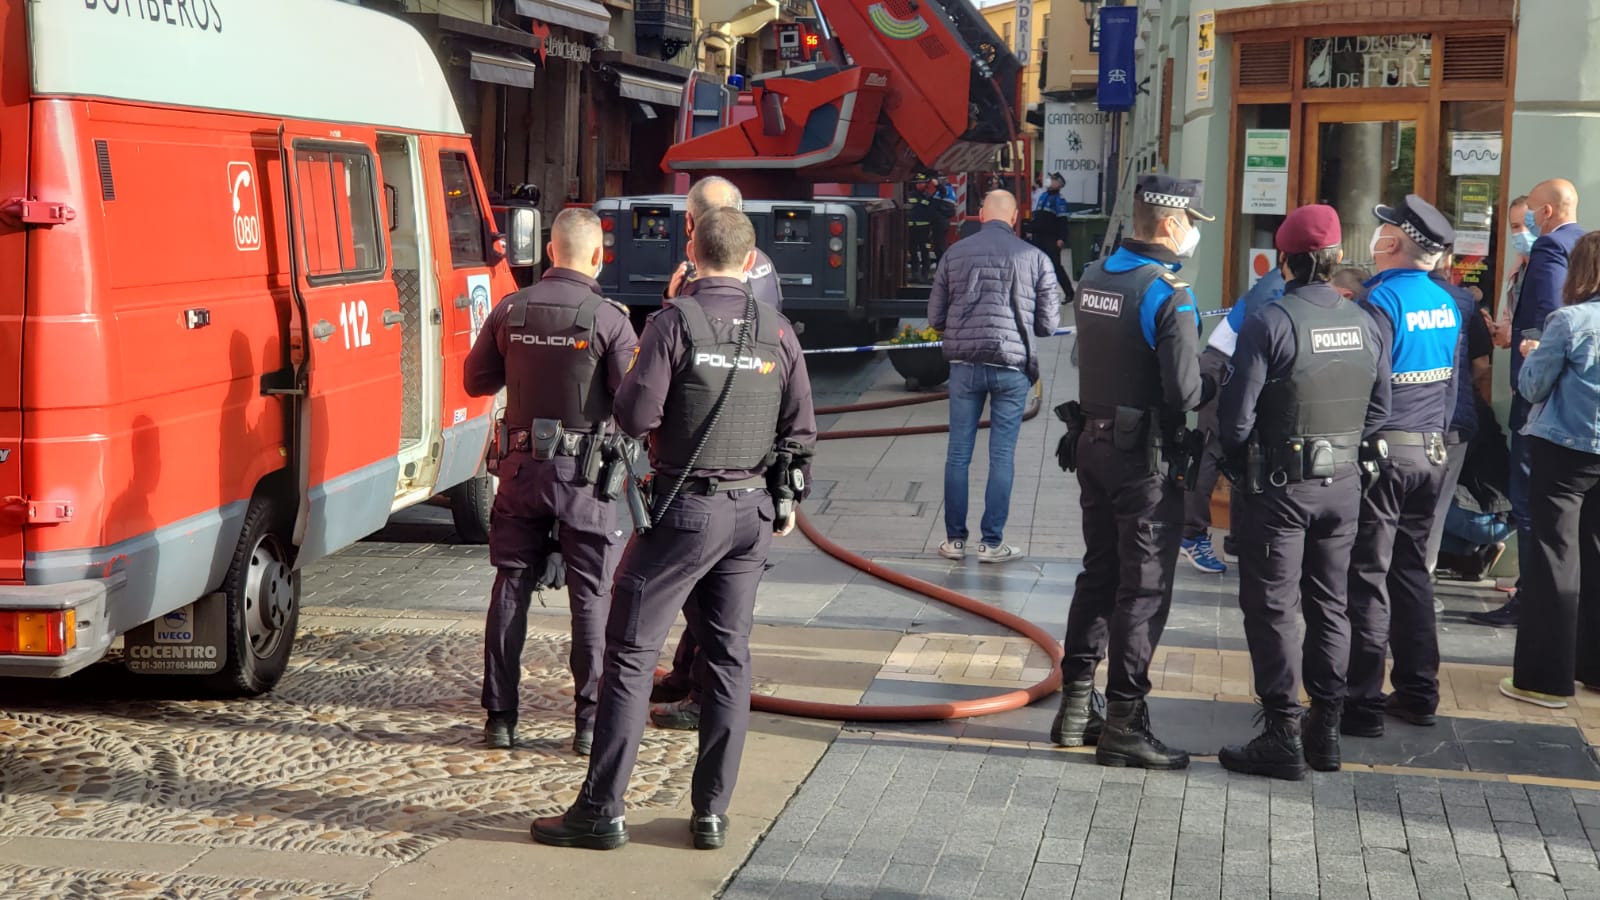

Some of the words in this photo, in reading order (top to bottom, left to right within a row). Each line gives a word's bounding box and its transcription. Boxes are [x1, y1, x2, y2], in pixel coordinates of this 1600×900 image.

[85, 0, 222, 33] BEROS
[1018, 0, 1030, 62] DRID
[1334, 36, 1352, 53] LA
[1336, 73, 1360, 88] DE
[1361, 54, 1421, 88] FER
[1055, 159, 1096, 170] MADRID
[237, 215, 258, 244] 080
[1082, 293, 1119, 312] POLICIA
[339, 300, 371, 350] 112
[510, 334, 577, 346] POLICIA
[1314, 332, 1361, 348] POLICIA
[158, 632, 191, 640] IVECO
[130, 645, 217, 659] COCENTRO
